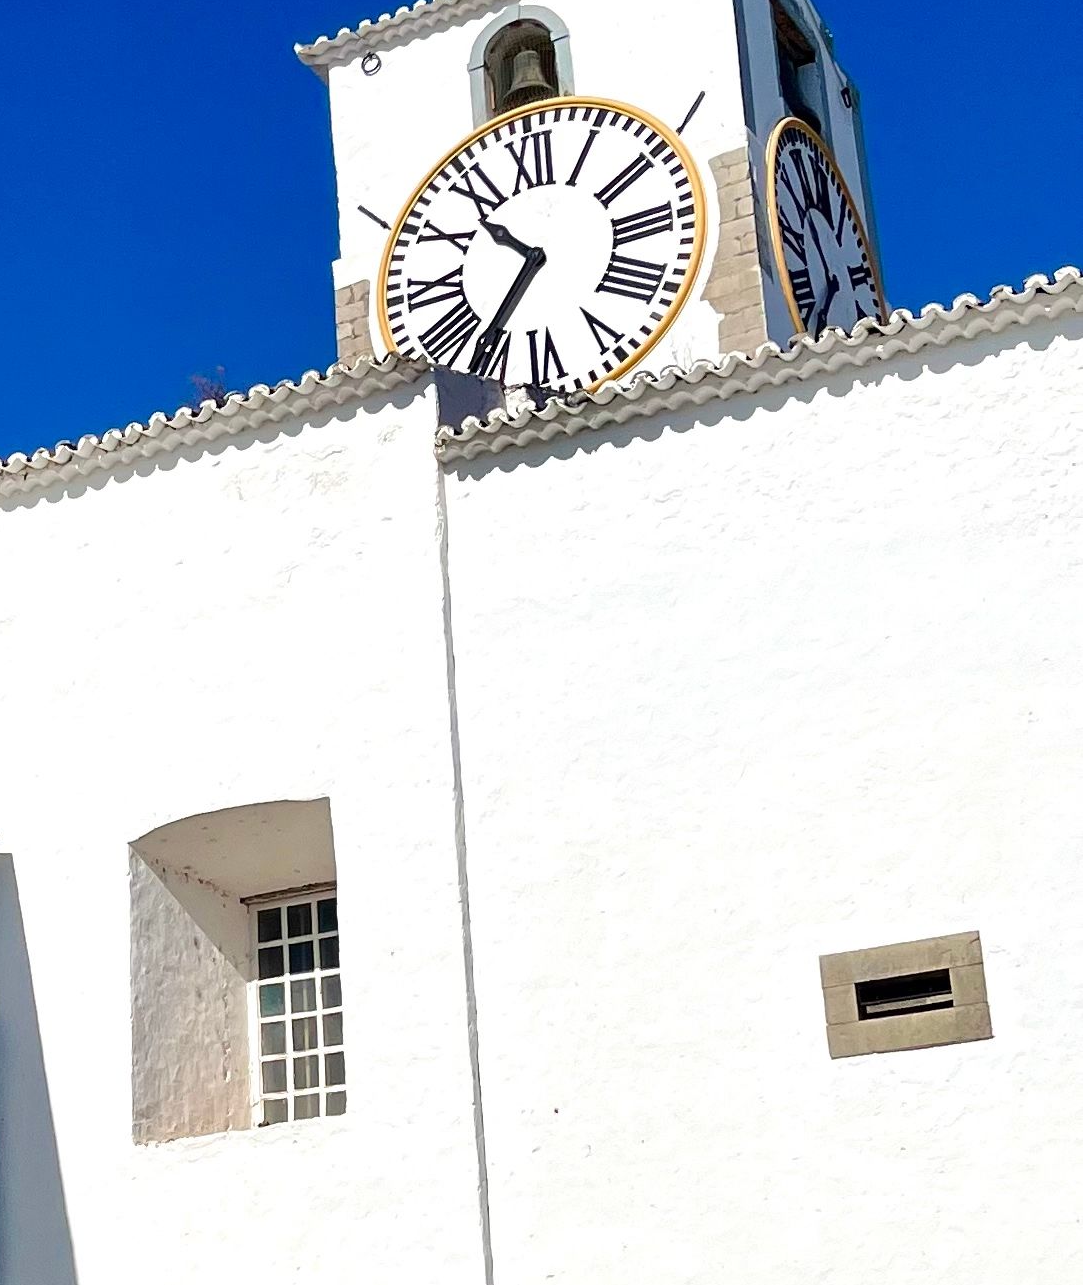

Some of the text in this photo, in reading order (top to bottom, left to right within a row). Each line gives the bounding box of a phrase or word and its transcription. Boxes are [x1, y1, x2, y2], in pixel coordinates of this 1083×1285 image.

[504, 129, 556, 197] XII
[565, 130, 600, 186] I
[593, 152, 655, 210] II
[448, 162, 509, 221] XI
[416, 220, 478, 255] X
[610, 200, 673, 249] III
[407, 264, 465, 313] IX
[594, 251, 668, 304] IIII
[417, 299, 482, 368] VIII
[526, 325, 569, 385] VI
[579, 306, 625, 355] V
